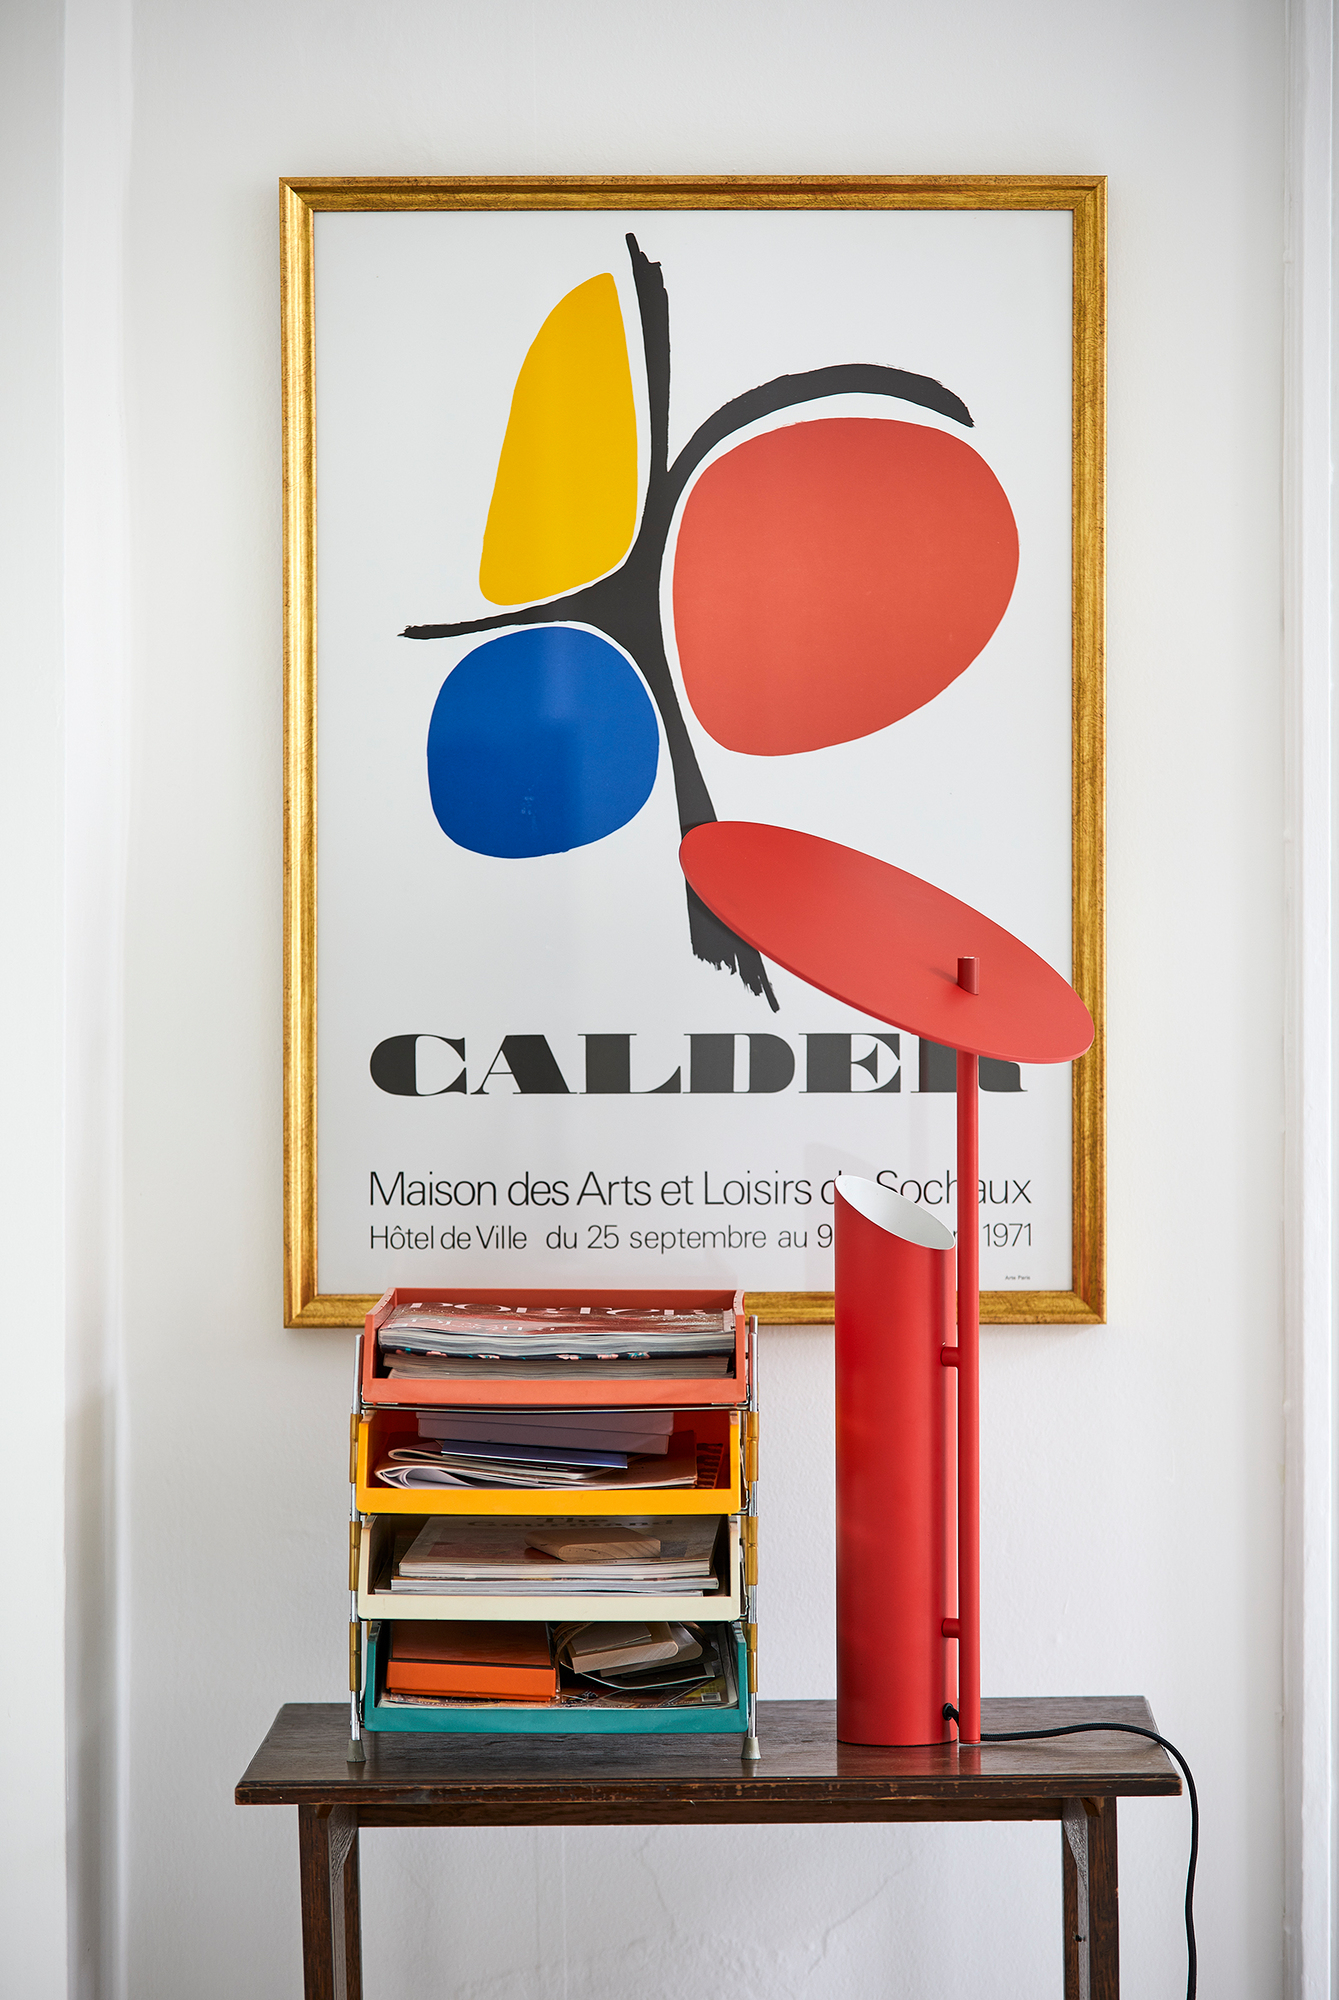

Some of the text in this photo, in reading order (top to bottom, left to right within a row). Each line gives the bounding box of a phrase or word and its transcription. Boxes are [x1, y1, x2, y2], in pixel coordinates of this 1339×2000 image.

[370, 1171, 497, 1206] Maison
[508, 1171, 570, 1206] des
[577, 1171, 652, 1206] Arts
[660, 1175, 694, 1206] et
[704, 1170, 813, 1206] Loisirs
[370, 1225, 434, 1250] Hôtel
[440, 1225, 472, 1250] de
[476, 1225, 528, 1250] Ville
[546, 1225, 578, 1250] du
[588, 1225, 620, 1250] 25
[630, 1224, 767, 1256] septembre
[778, 1231, 808, 1250] au
[982, 1222, 1032, 1248] 1971
